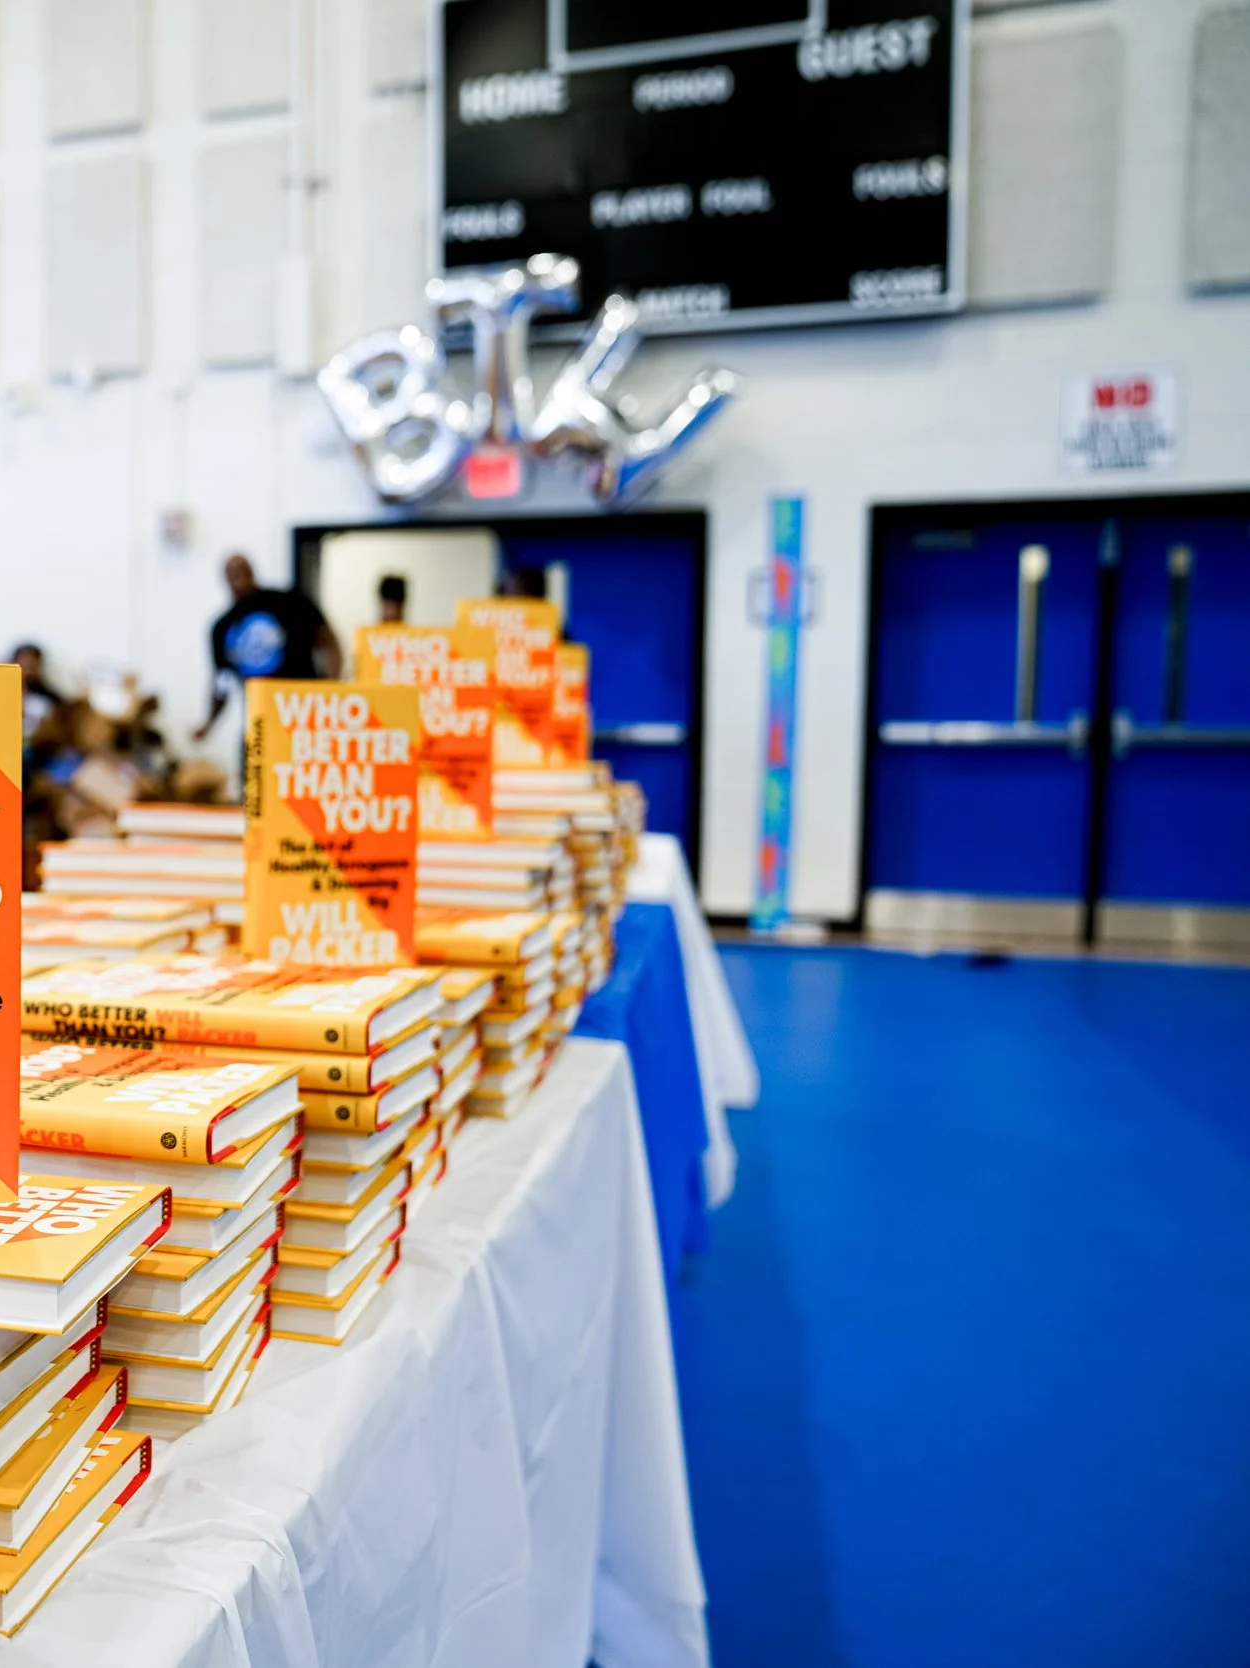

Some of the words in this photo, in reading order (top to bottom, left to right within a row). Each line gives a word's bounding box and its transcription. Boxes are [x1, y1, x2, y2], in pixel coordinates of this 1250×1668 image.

[798, 17, 938, 81] GUEST
[459, 70, 568, 124] HOME
[274, 692, 369, 729] WHO
[291, 728, 411, 764] BETTER
[273, 764, 373, 797] THAN
[320, 797, 412, 833] YOU?
[280, 901, 363, 935] WILL
[268, 930, 399, 966] PACKER
[24, 1001, 72, 1017] WHO
[78, 1004, 149, 1022] BETTER
[53, 1020, 111, 1039] THAN
[114, 1025, 166, 1042] YOU?
[19, 1129, 86, 1150] ACKER
[33, 1185, 146, 1235] WHO
